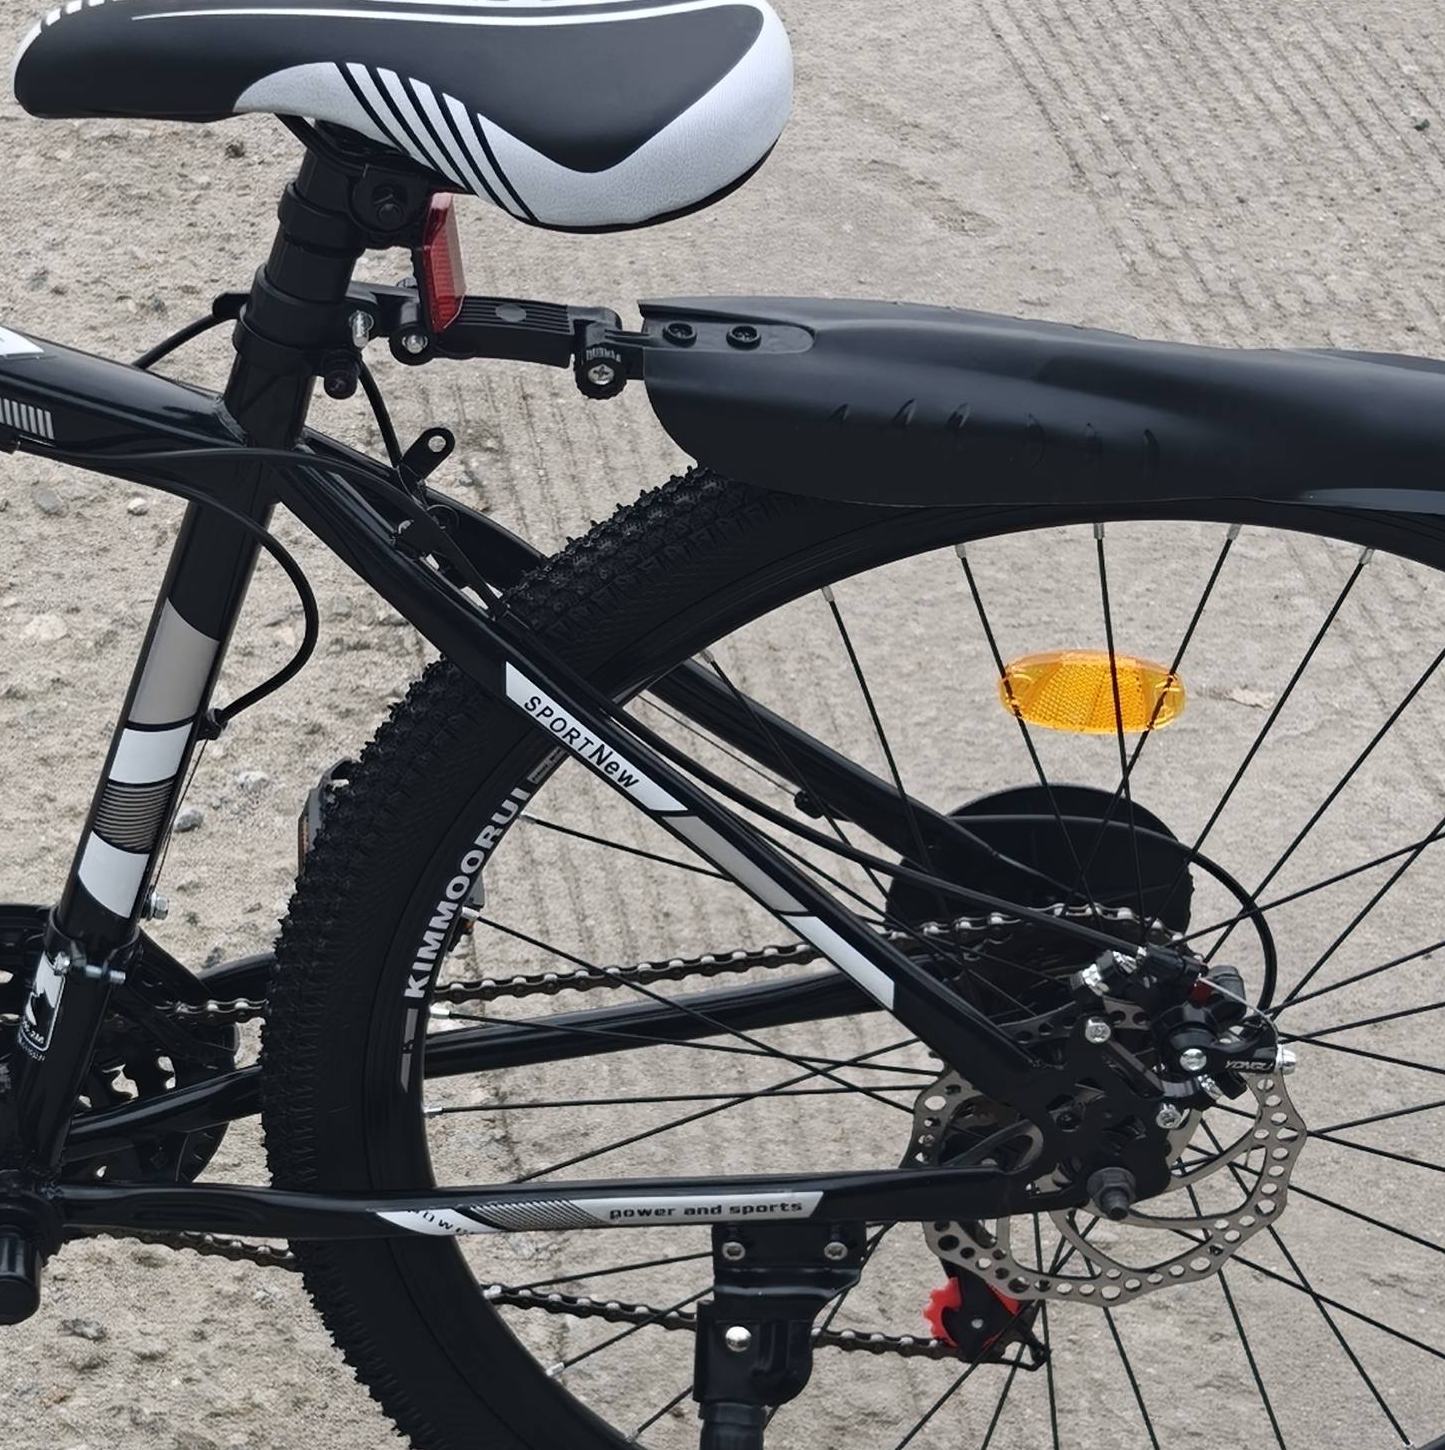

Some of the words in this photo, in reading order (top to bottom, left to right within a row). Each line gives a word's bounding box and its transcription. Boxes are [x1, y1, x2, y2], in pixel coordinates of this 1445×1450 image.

[523, 695, 595, 753] SPORT
[404, 787, 535, 999] KIMMOORUI
[609, 1206, 677, 1221] power
[683, 1204, 723, 1217] and
[728, 1200, 803, 1216] sports
